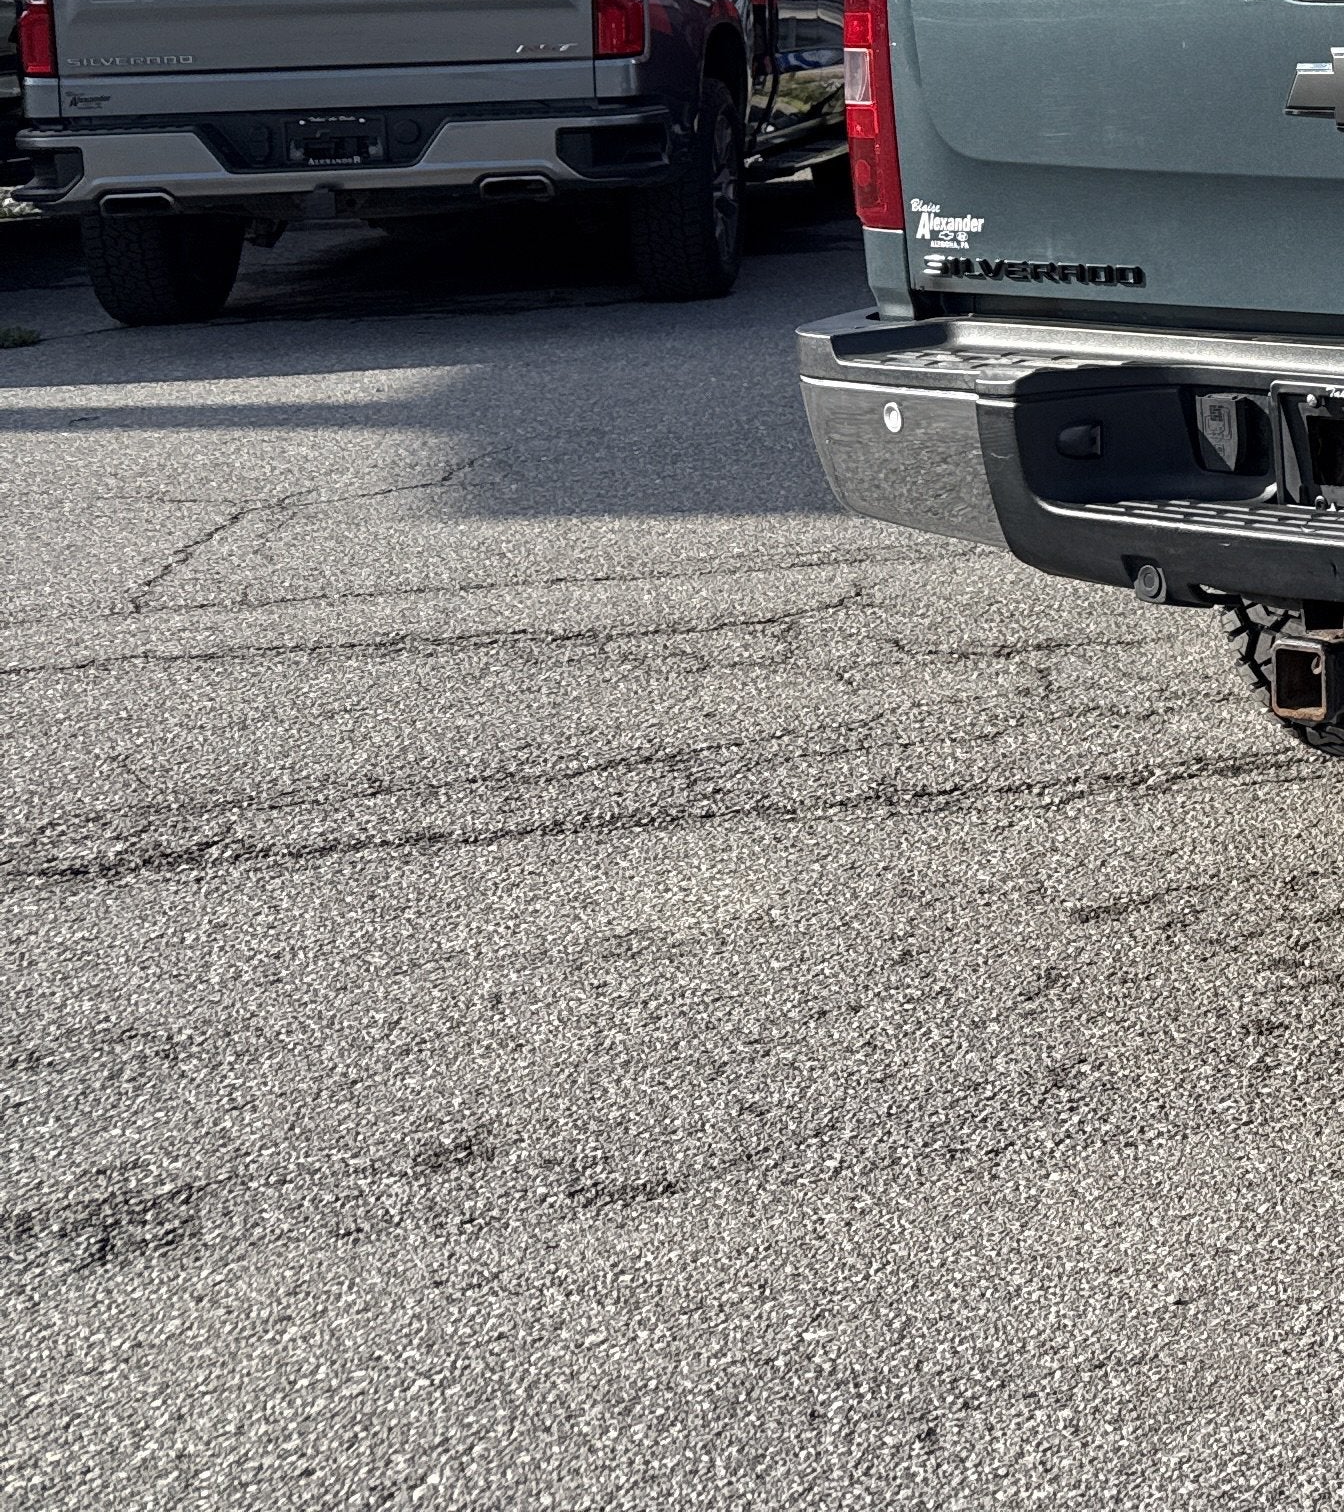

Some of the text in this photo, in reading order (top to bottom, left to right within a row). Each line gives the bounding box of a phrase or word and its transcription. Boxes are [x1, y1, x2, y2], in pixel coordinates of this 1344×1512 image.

[66, 55, 194, 67] SILVERADO
[910, 198, 941, 213] Blaise
[915, 212, 985, 239] Alexander
[923, 254, 1147, 288] SILVERADO
